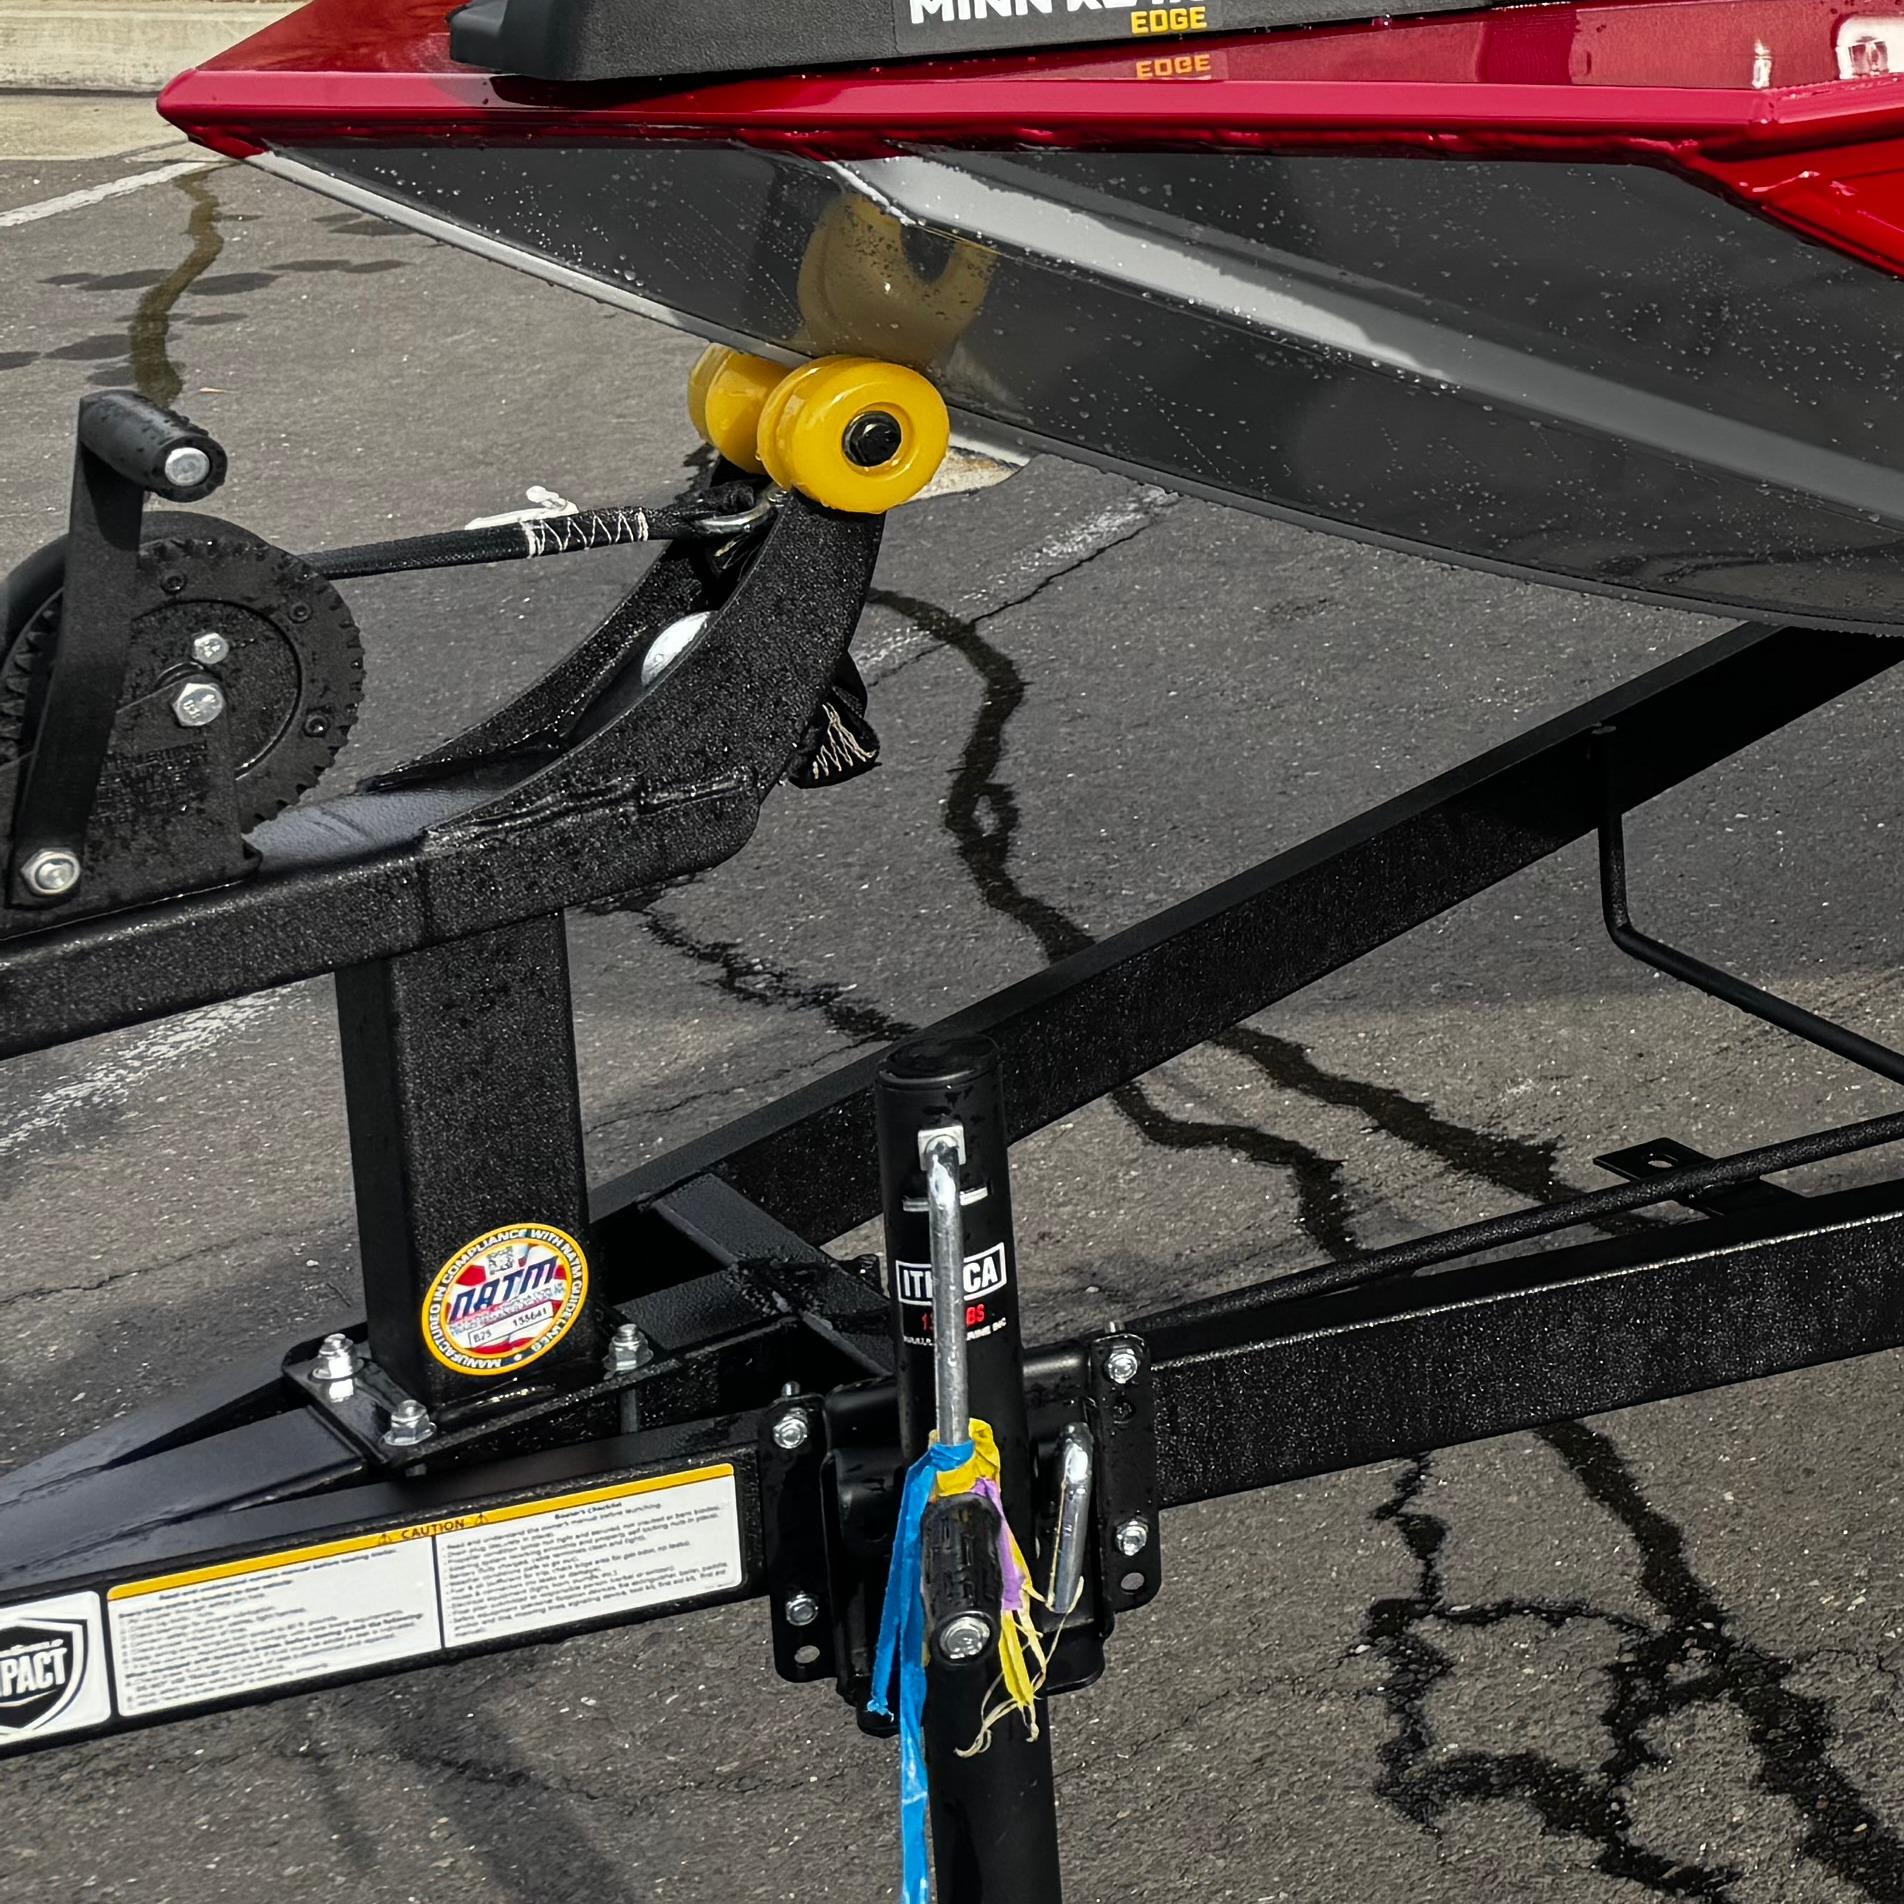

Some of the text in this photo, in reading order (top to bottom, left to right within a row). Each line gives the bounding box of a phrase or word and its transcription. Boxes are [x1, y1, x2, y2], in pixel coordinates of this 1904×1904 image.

[1130, 6, 1208, 35] EDGE
[530, 1229, 562, 1248] WITH
[441, 1228, 528, 1285] COMPLIANCE
[561, 1247, 583, 1280] NATM
[902, 1256, 999, 1298] ITCA
[432, 1286, 445, 1302] IN
[429, 1302, 502, 1369] MANUFACTURED
[401, 1518, 466, 1540] CAUTION
[0, 1648, 67, 1696] PACT
